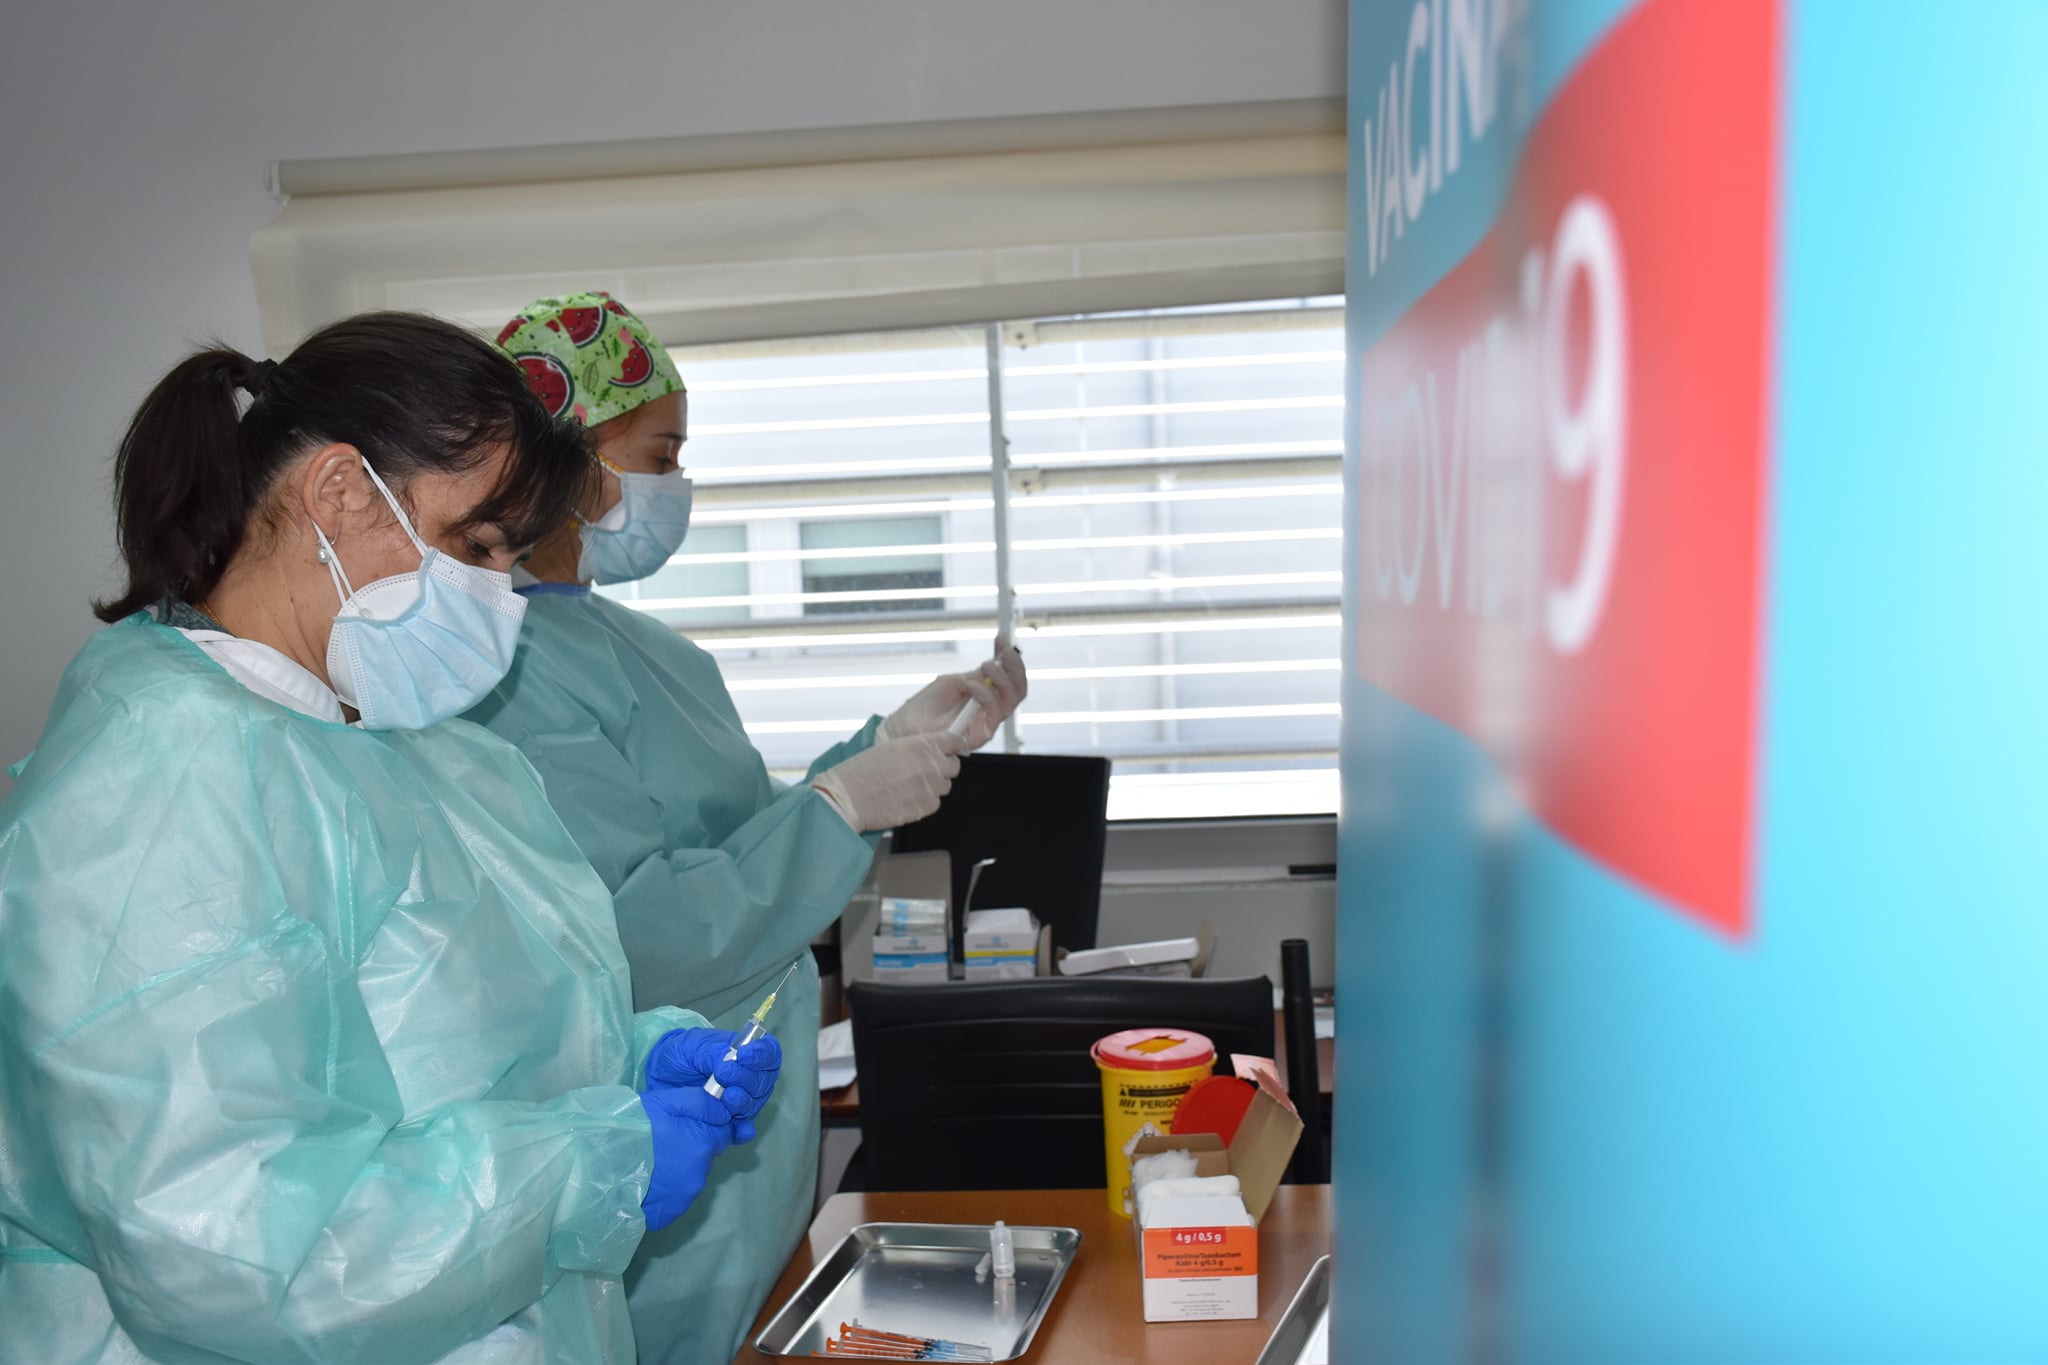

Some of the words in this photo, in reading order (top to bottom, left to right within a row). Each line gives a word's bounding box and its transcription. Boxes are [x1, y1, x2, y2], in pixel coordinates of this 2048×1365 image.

[1176, 1233, 1182, 1242] 4
[1184, 1234, 1191, 1244] g
[1198, 1232, 1213, 1243] 0,5
[1214, 1233, 1222, 1243] g
